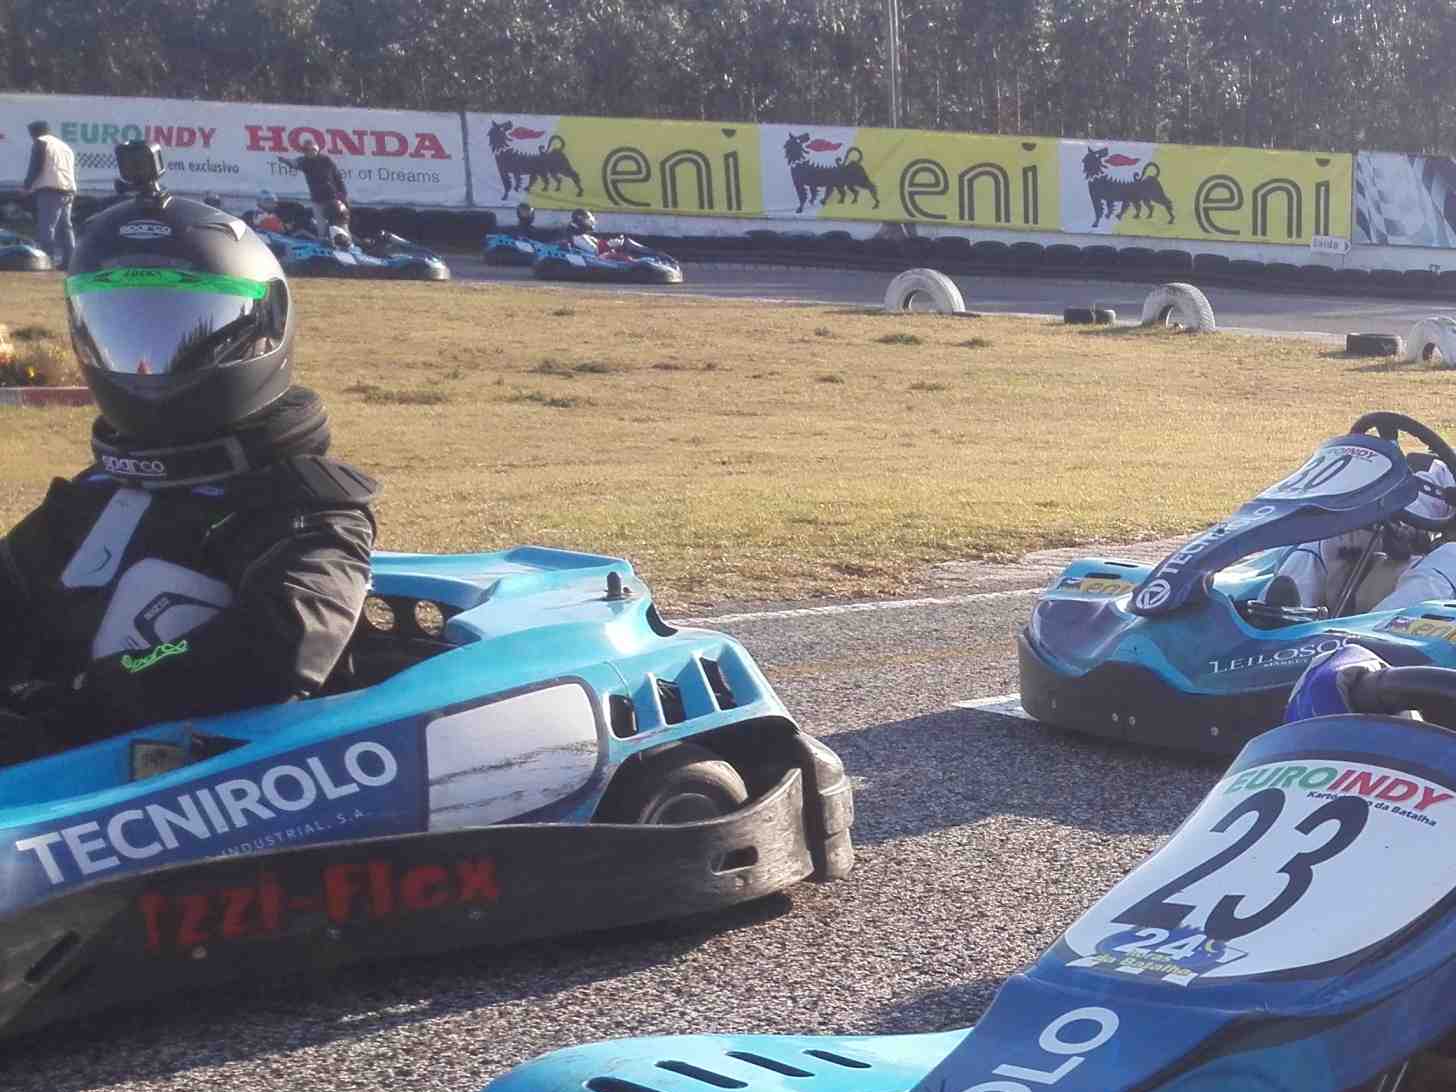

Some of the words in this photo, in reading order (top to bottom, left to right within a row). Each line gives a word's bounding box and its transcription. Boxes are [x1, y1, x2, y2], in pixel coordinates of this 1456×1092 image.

[60, 121, 216, 148] EUROINDY
[245, 125, 451, 160] HONDA
[188, 159, 240, 174] exclusivo
[267, 161, 297, 177] The
[358, 168, 373, 180] of
[378, 167, 441, 183] Dreams
[603, 128, 742, 212] eni
[900, 142, 1040, 225] eni
[1195, 158, 1331, 239] eni
[1223, 766, 1454, 812] EUROINDY
[16, 741, 398, 885] TECNIROLO
[1391, 806, 1437, 827] Batalha
[1111, 787, 1371, 941] 23
[1112, 928, 1207, 961] 24
